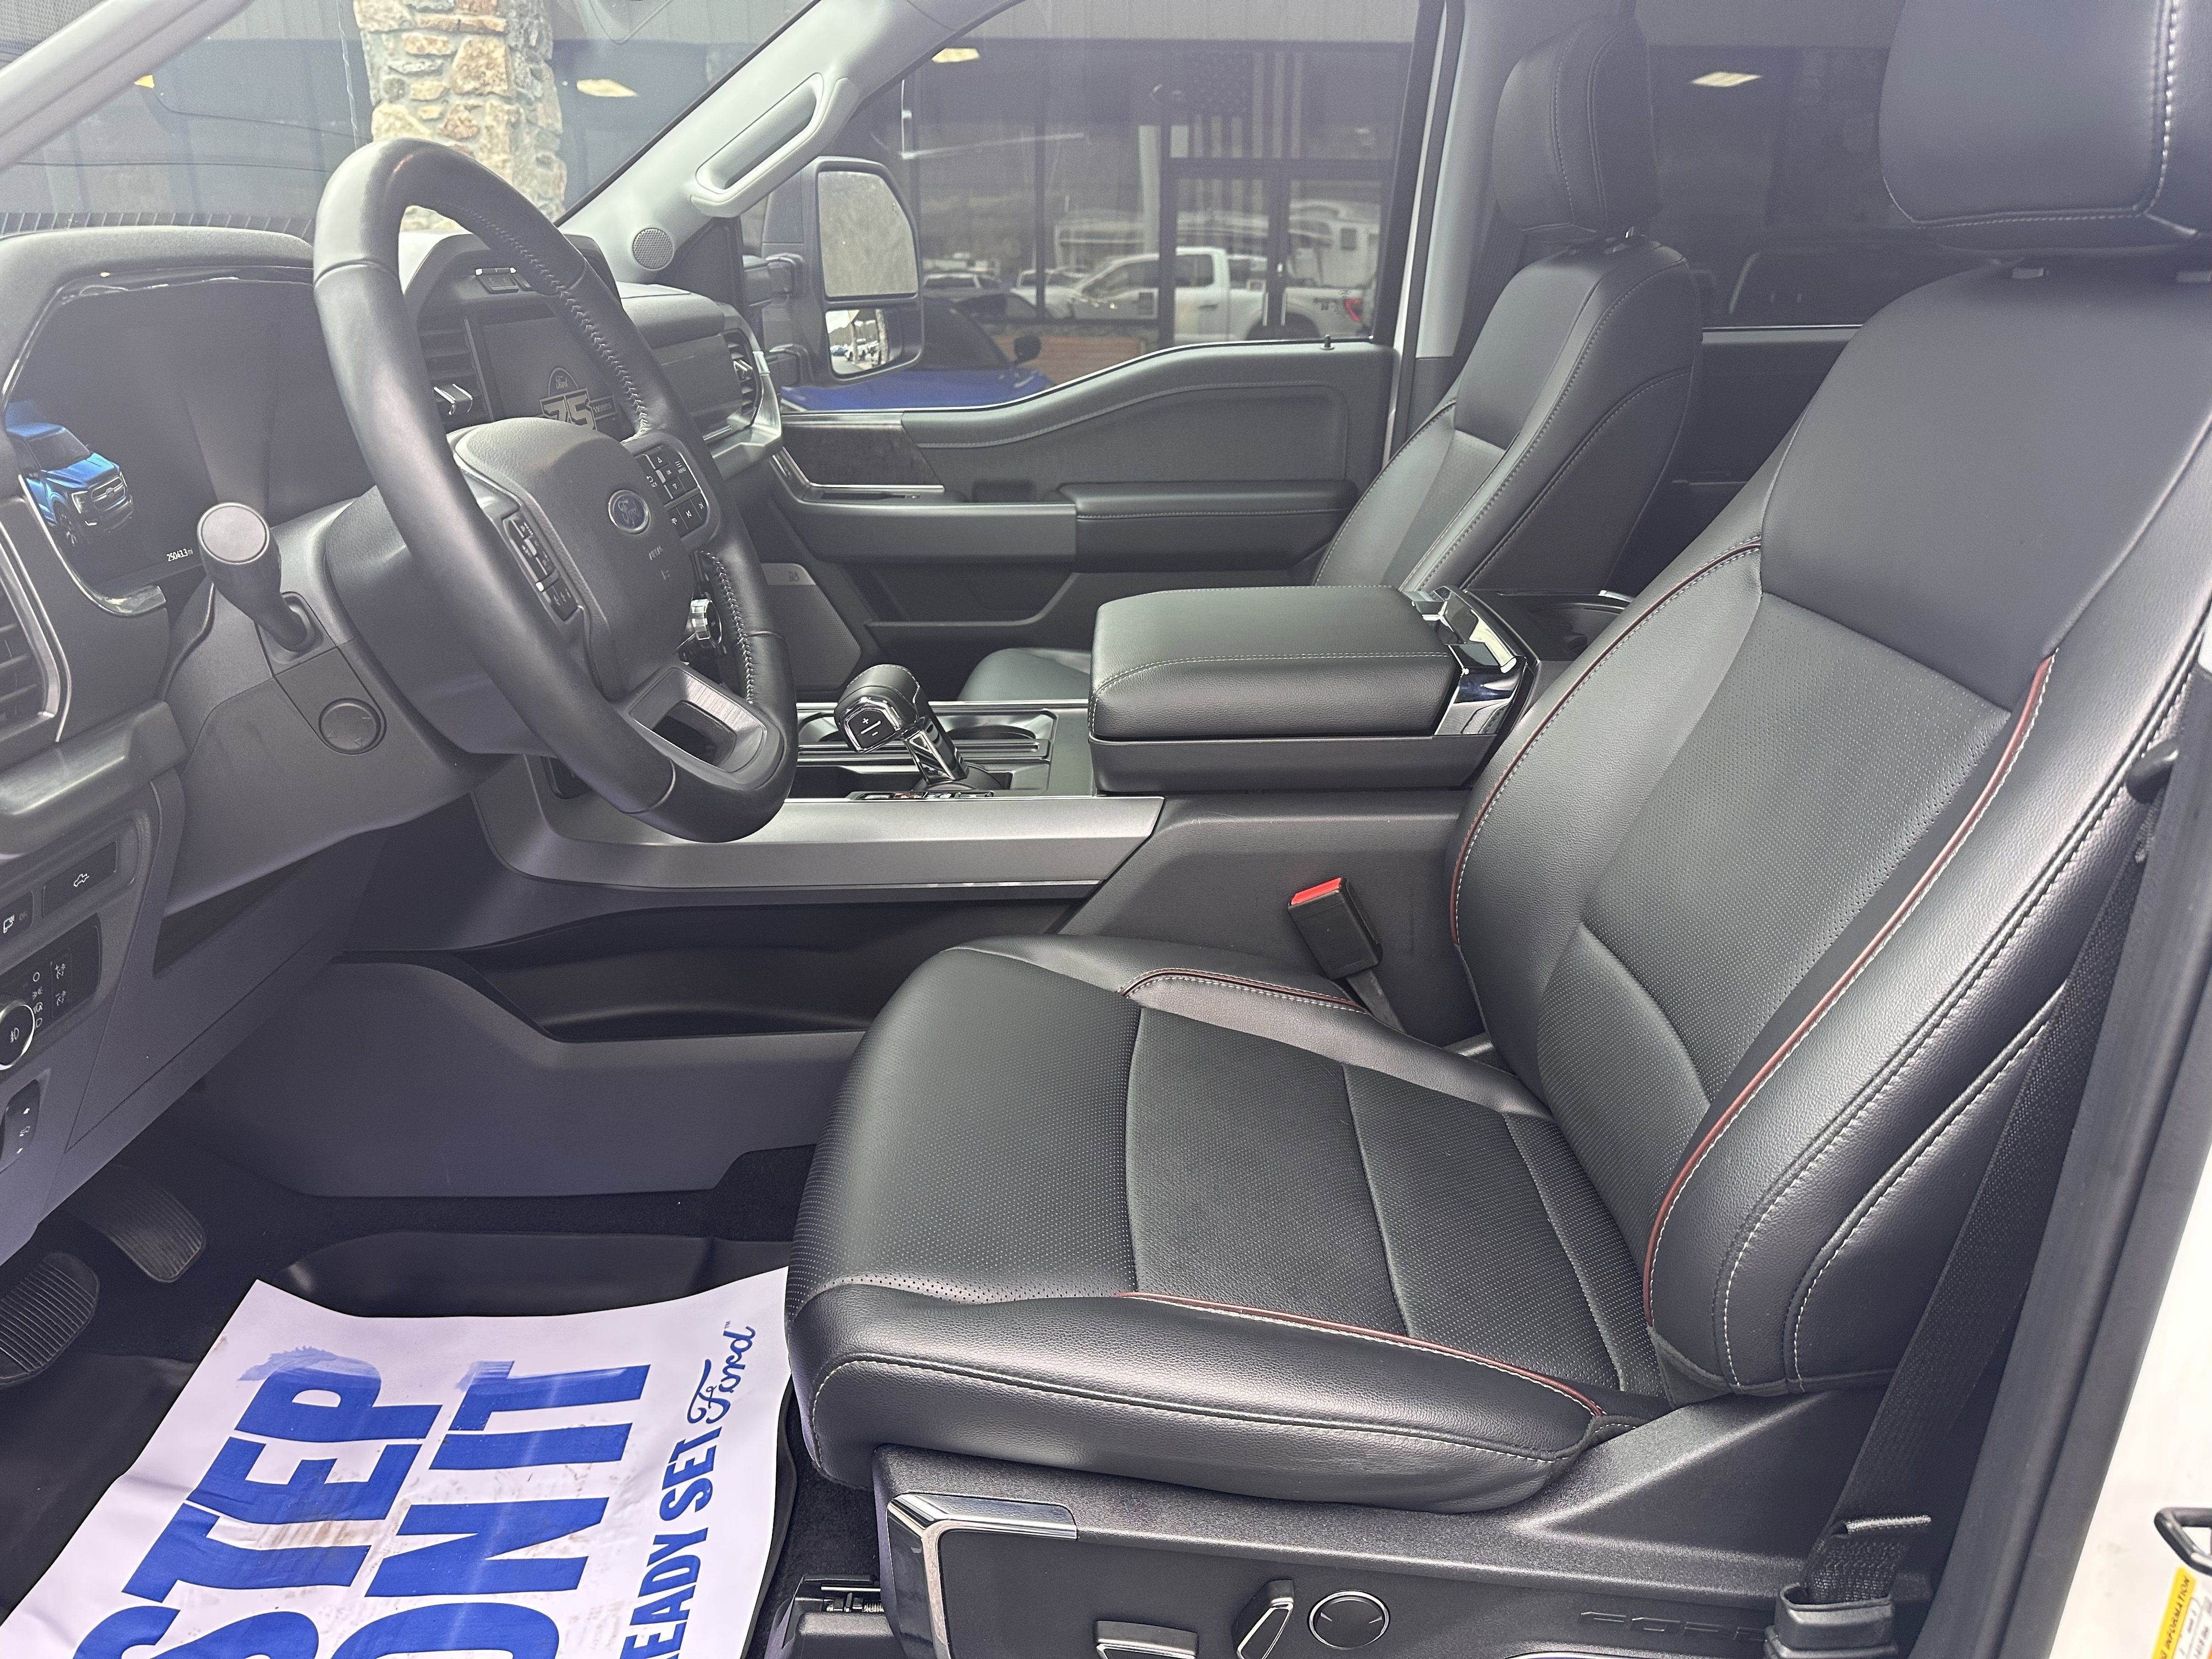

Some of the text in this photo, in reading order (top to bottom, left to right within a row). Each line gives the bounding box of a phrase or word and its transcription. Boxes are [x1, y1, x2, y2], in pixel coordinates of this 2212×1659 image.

[555, 375, 568, 390] Ford
[428, 1360, 651, 1471] IT
[687, 1325, 756, 1424] Ford
[659, 1426, 723, 1521] SET
[619, 1527, 708, 1659] EADY
[2164, 1575, 2190, 1650] INFORMATION
